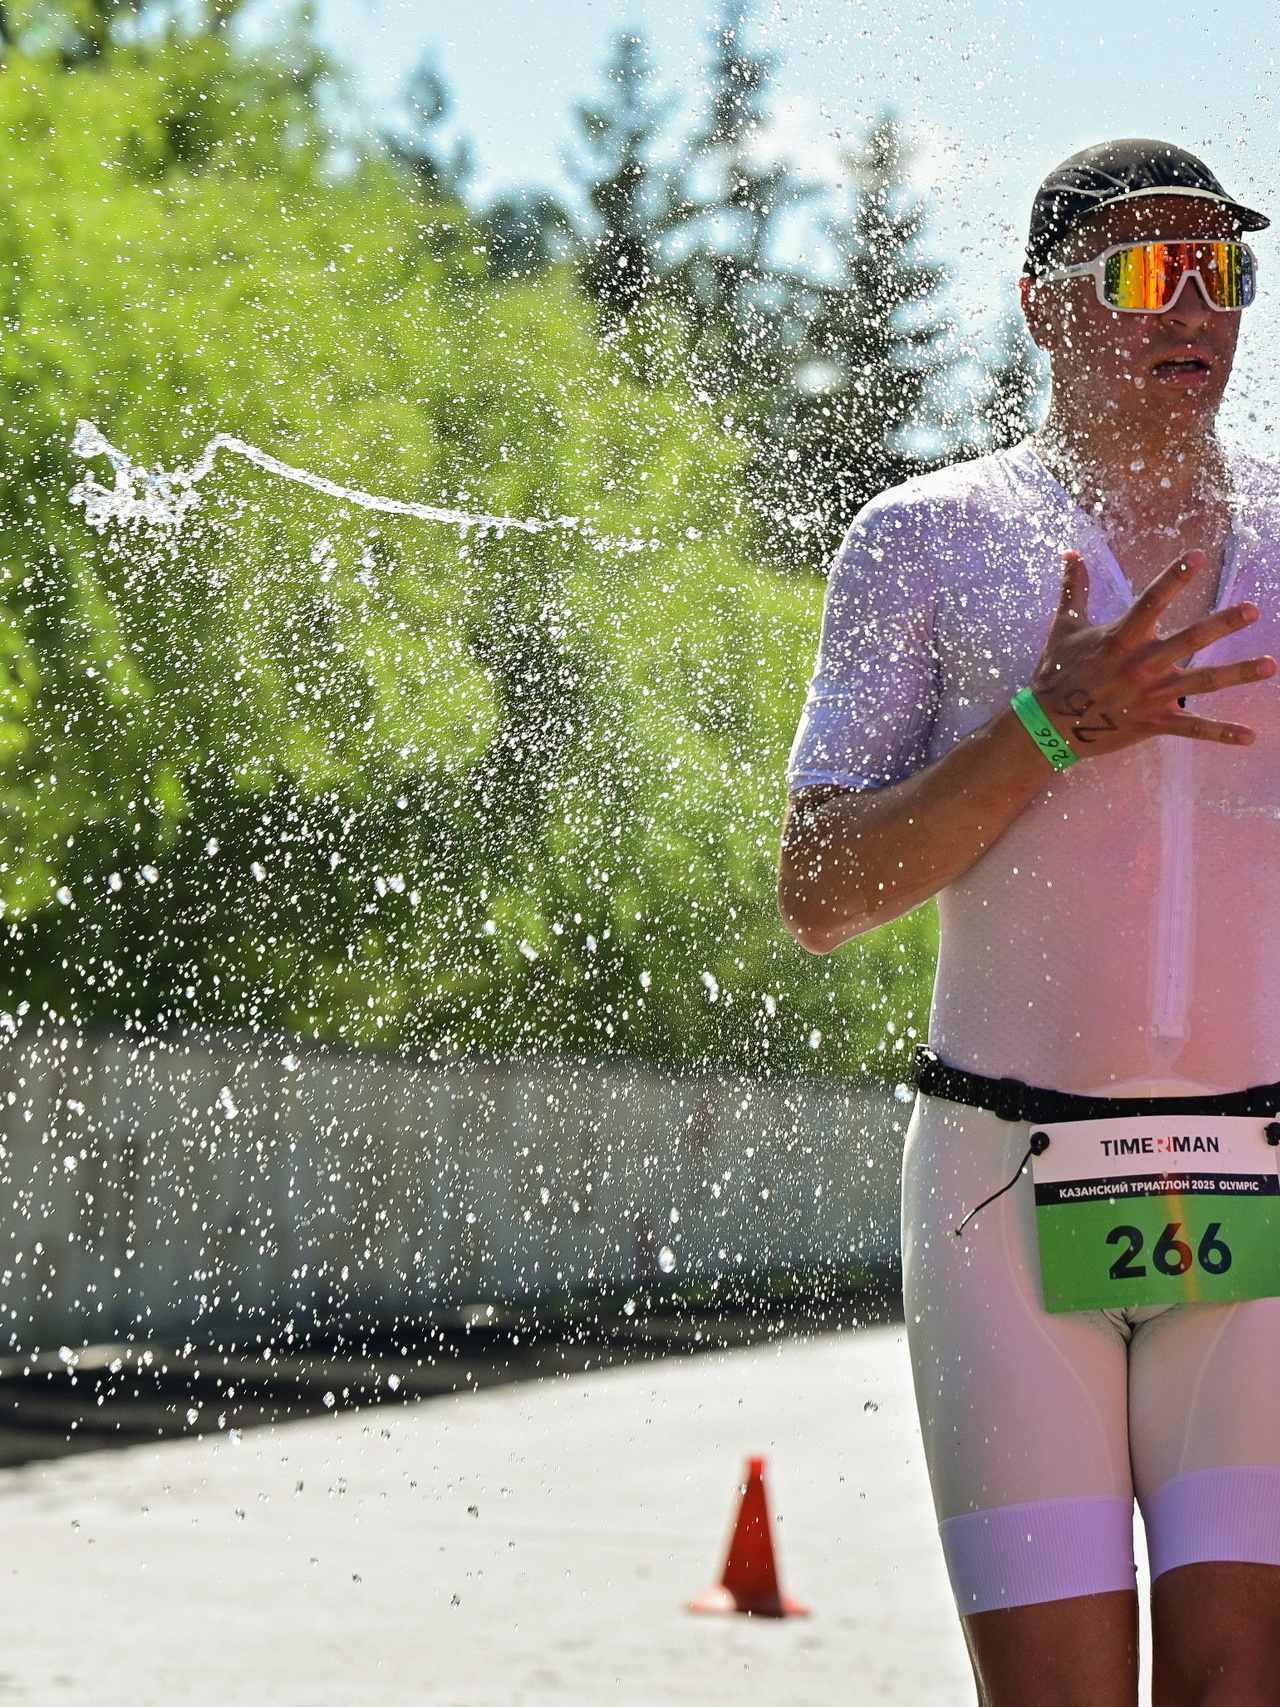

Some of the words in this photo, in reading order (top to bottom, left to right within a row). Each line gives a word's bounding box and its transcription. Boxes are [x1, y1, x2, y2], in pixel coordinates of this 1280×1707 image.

[1034, 727, 1070, 762] 266
[1059, 1181, 1128, 1198] КАЗАНСКИЙ
[1130, 1180, 1189, 1192] ТРИАТЛОН
[1191, 1180, 1215, 1190] 2025
[1219, 1181, 1259, 1191] OLYMPIC
[1105, 1223, 1232, 1280] 266
